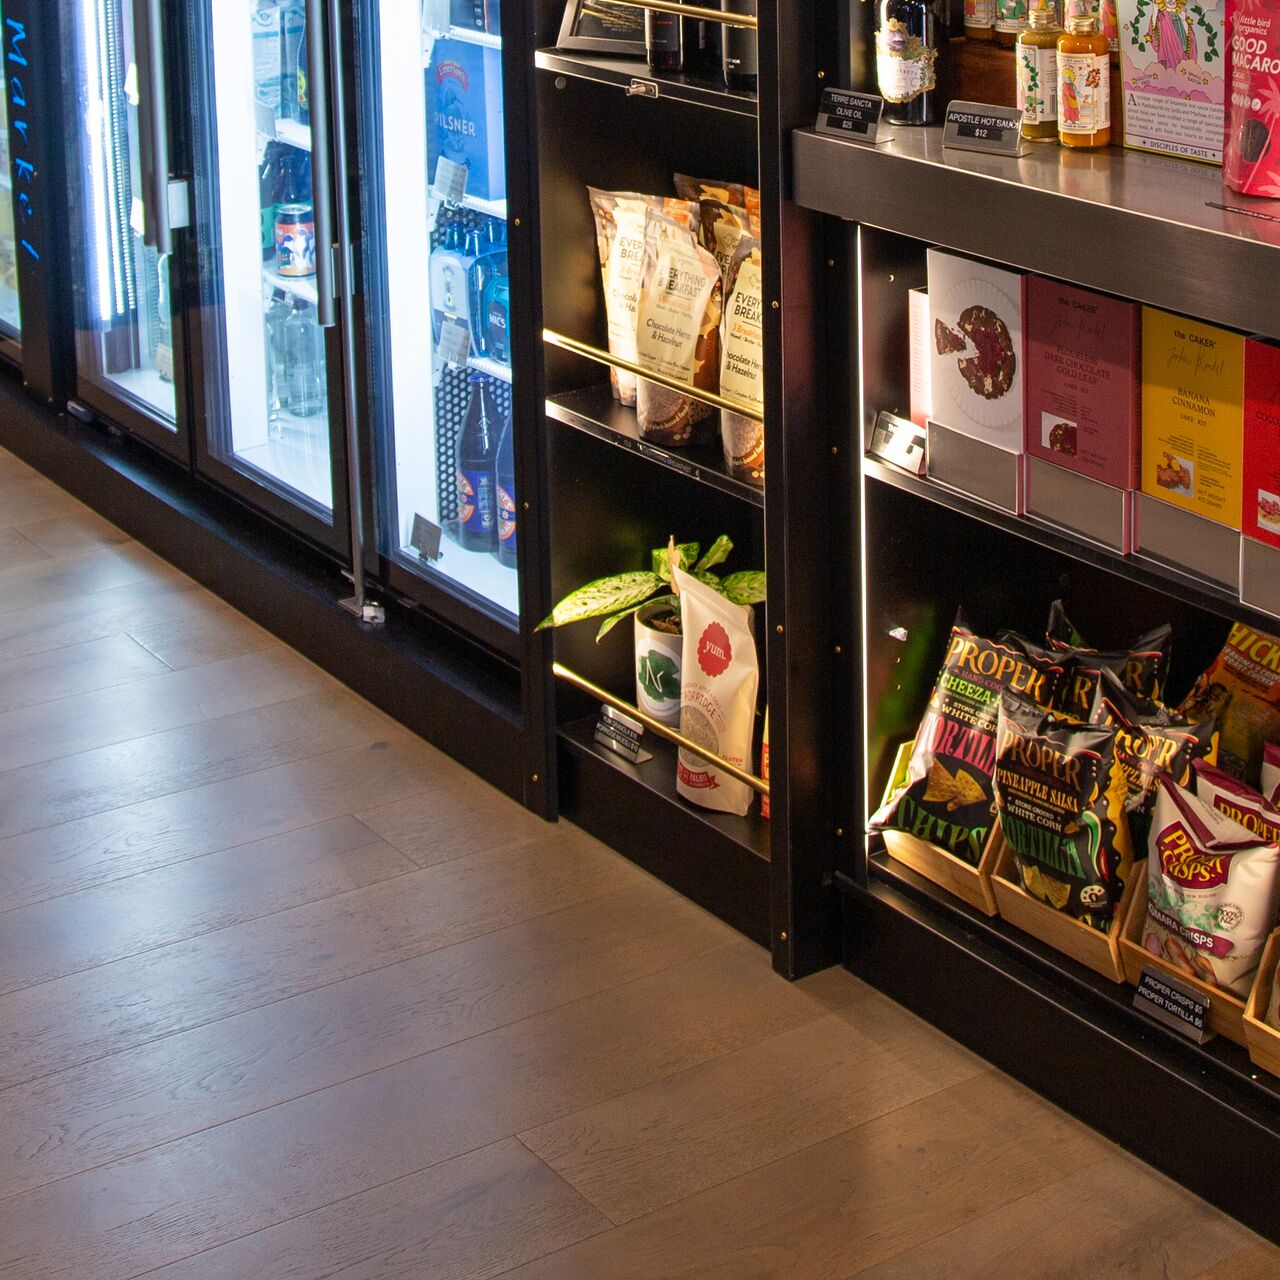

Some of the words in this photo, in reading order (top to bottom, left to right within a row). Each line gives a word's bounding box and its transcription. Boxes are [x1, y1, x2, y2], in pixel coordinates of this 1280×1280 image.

[1239, 25, 1267, 36] organics
[1232, 36, 1267, 55] GOOD
[831, 94, 848, 105] TERRE
[849, 97, 872, 109] SANCTA
[836, 107, 852, 118] OLIVE
[853, 110, 862, 119] OIL
[948, 113, 979, 125] APOSTLE
[980, 117, 996, 126] HOT
[433, 110, 477, 137] PILSNER
[842, 120, 853, 129] $25
[974, 129, 988, 138] $12
[1150, 141, 1178, 153] DISCIPLES
[1180, 146, 1189, 155] OF
[1190, 148, 1209, 158] TASTE
[658, 331, 683, 349] Hazelnut
[1174, 329, 1186, 340] the
[1189, 334, 1216, 349] CAKER
[1177, 387, 1210, 405] BANANA
[1172, 397, 1216, 417] CINNAMON
[703, 640, 726, 661] yum.
[943, 636, 1048, 702] PROPER
[1001, 727, 1082, 791] PROPER
[1007, 803, 1033, 821] WHITE
[1035, 816, 1062, 834] CORN
[1144, 976, 1170, 995] PROPER
[1170, 987, 1194, 1008] CRISPS
[1194, 1003, 1203, 1015] $5
